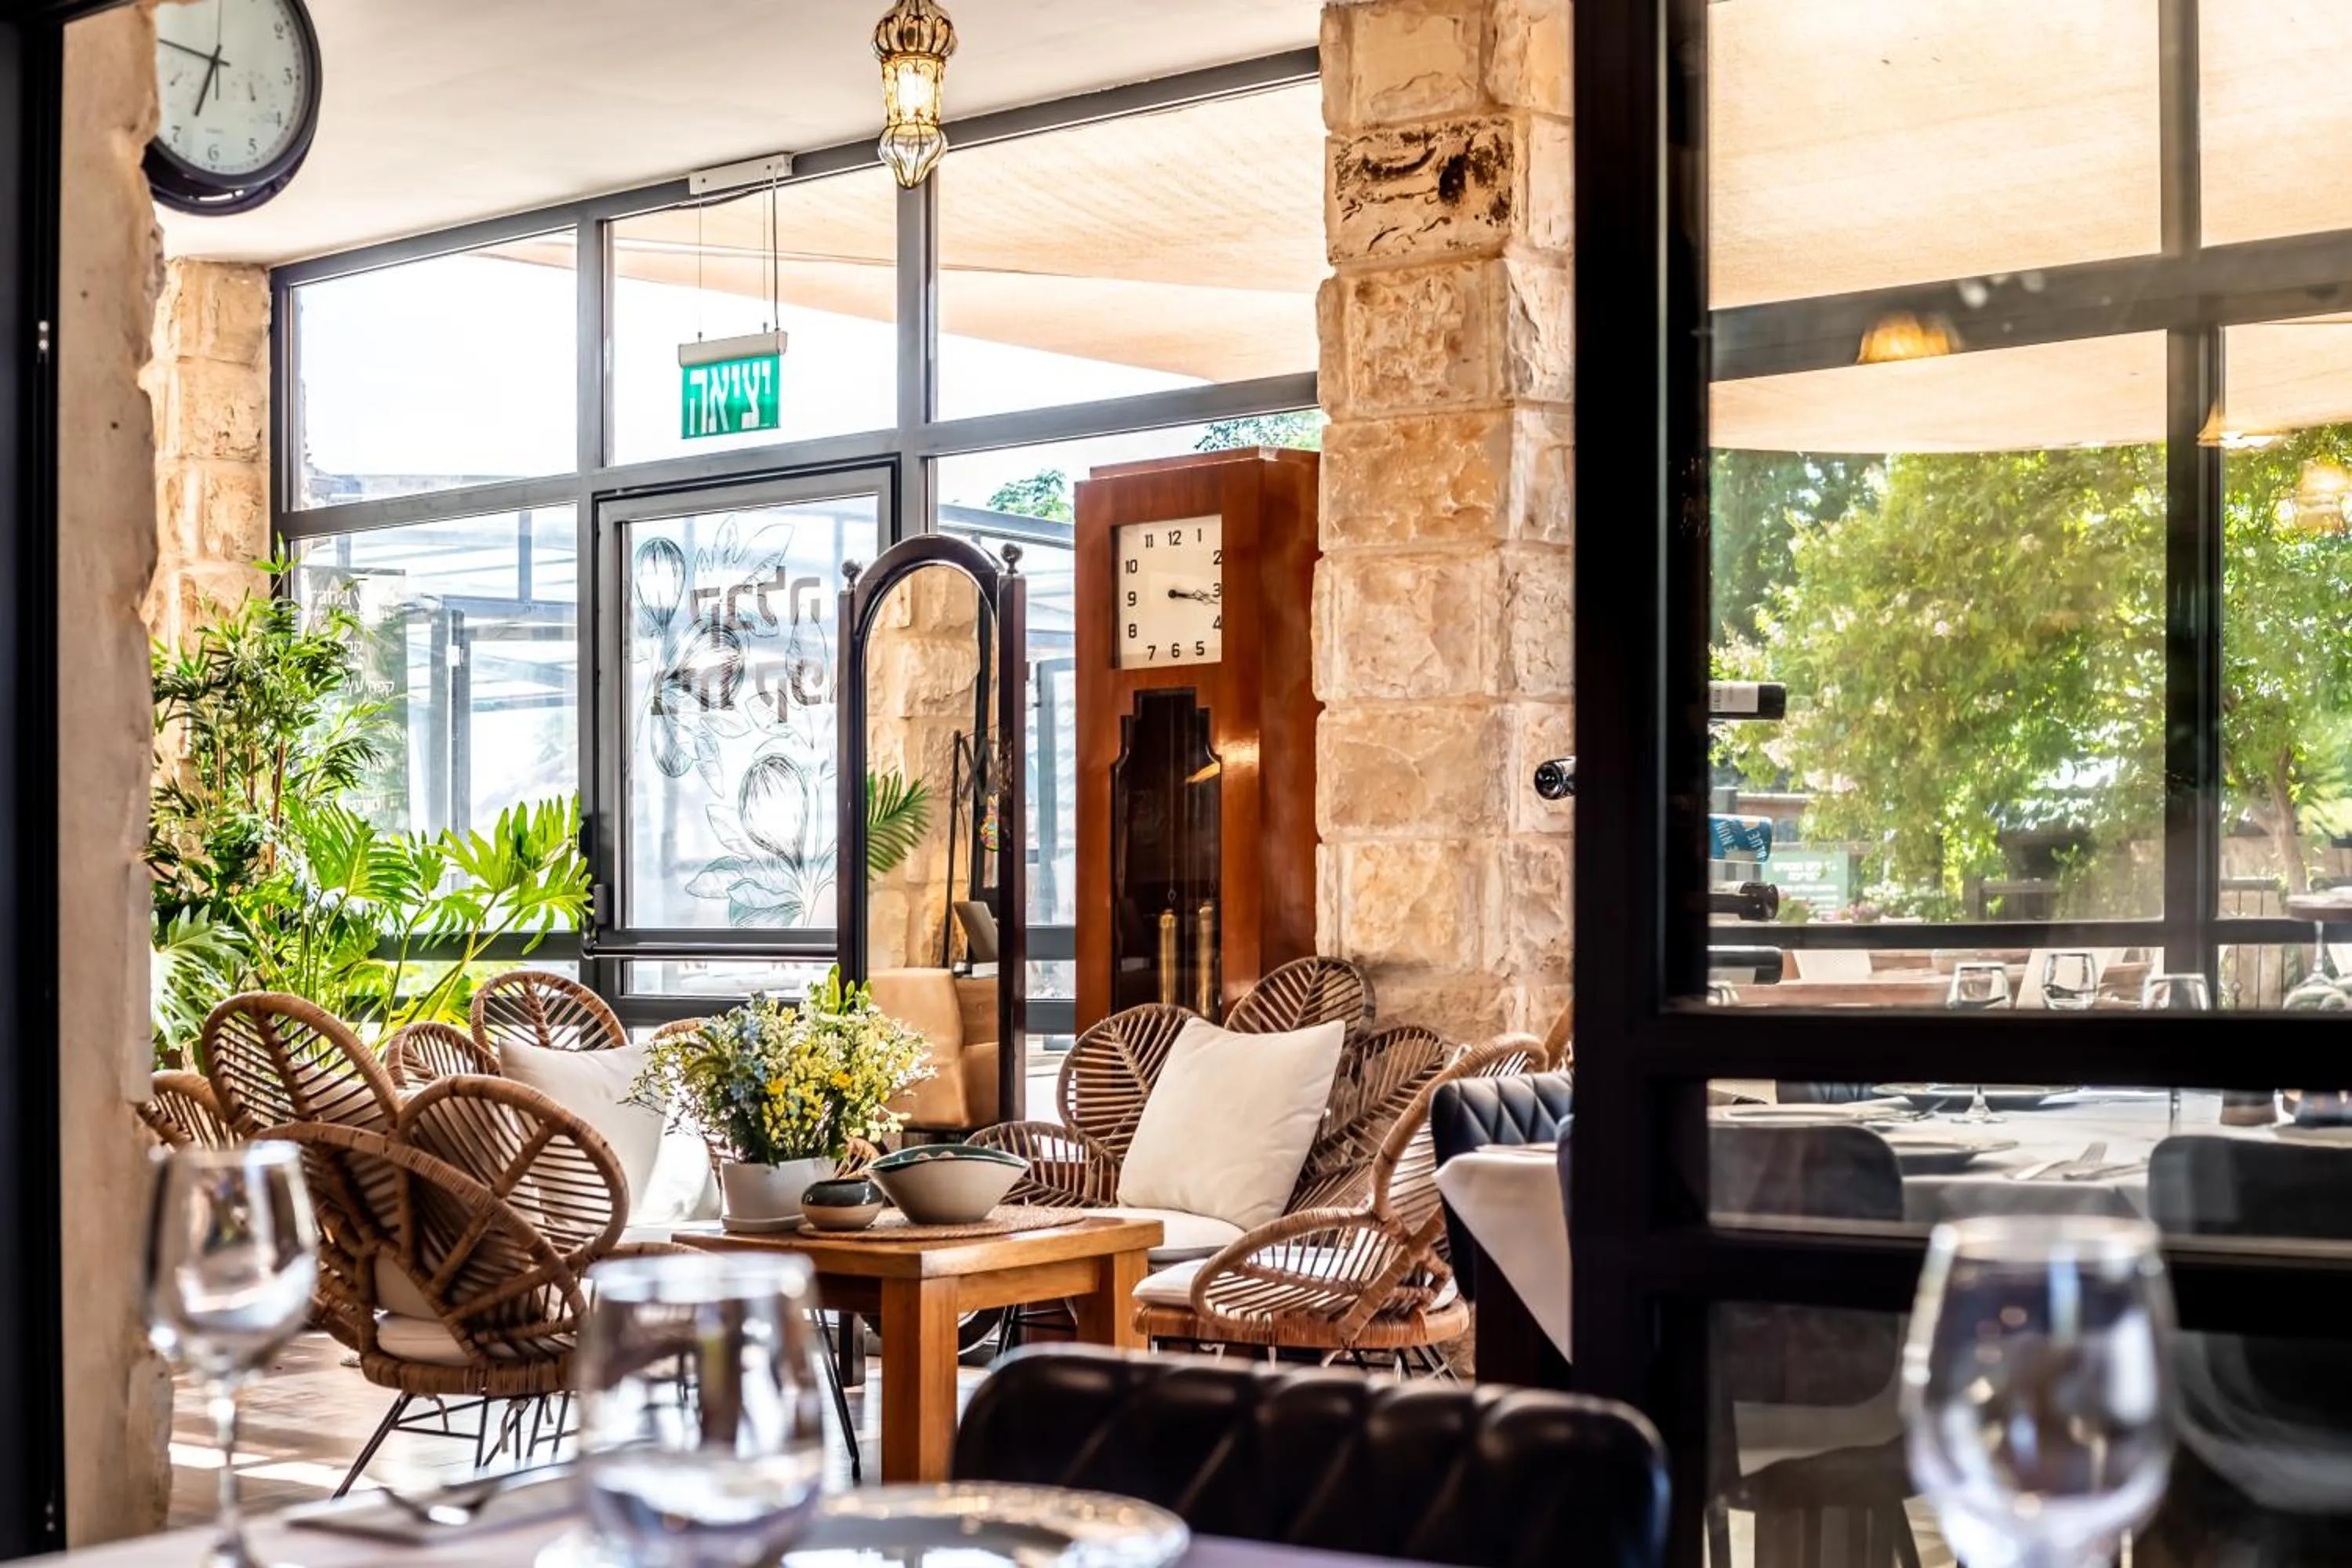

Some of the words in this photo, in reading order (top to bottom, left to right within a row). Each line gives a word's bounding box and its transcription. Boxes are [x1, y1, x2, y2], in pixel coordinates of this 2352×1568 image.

[208, 143, 220, 161] 6
[247, 138, 257, 156] 5
[688, 360, 771, 436] יציאה
[1145, 533, 1153, 548] 11
[1168, 530, 1181, 546] 12
[1197, 528, 1202, 543] 1
[1213, 550, 1222, 565] 2
[1125, 559, 1138, 574] 10
[1213, 583, 1221, 597] 3
[1127, 591, 1136, 607] 9
[1213, 615, 1222, 629] 4
[1128, 624, 1137, 638] 8
[1147, 645, 1156, 660] 7
[1171, 643, 1180, 658] 6
[1196, 641, 1204, 656] 5
